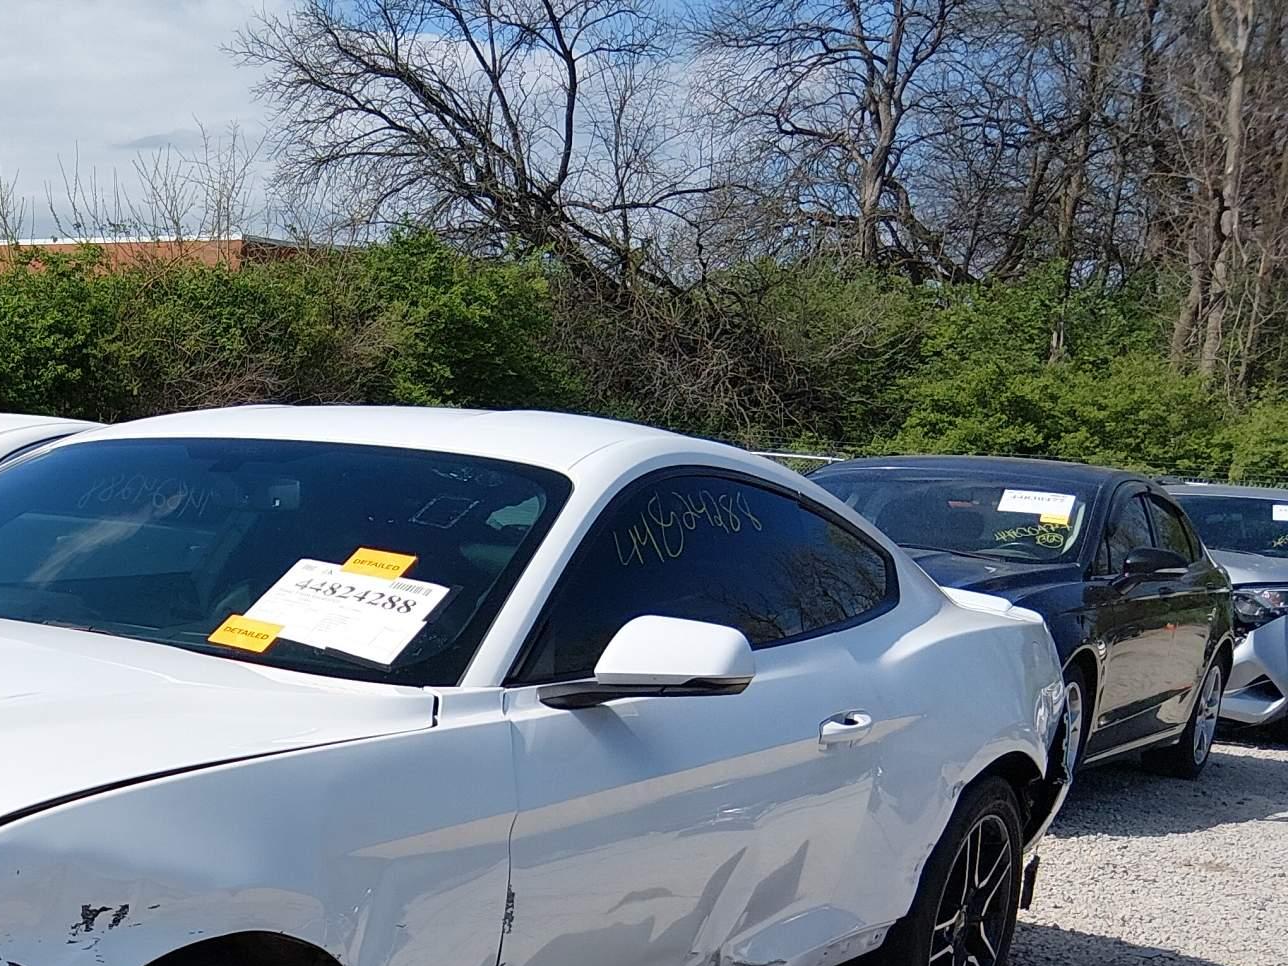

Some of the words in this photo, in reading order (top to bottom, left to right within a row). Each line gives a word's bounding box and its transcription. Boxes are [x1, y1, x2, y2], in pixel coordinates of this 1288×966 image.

[614, 488, 763, 567] 44824288
[352, 558, 401, 572] DETAILED
[295, 577, 418, 614] 44824288
[223, 625, 270, 641] DETAILED
